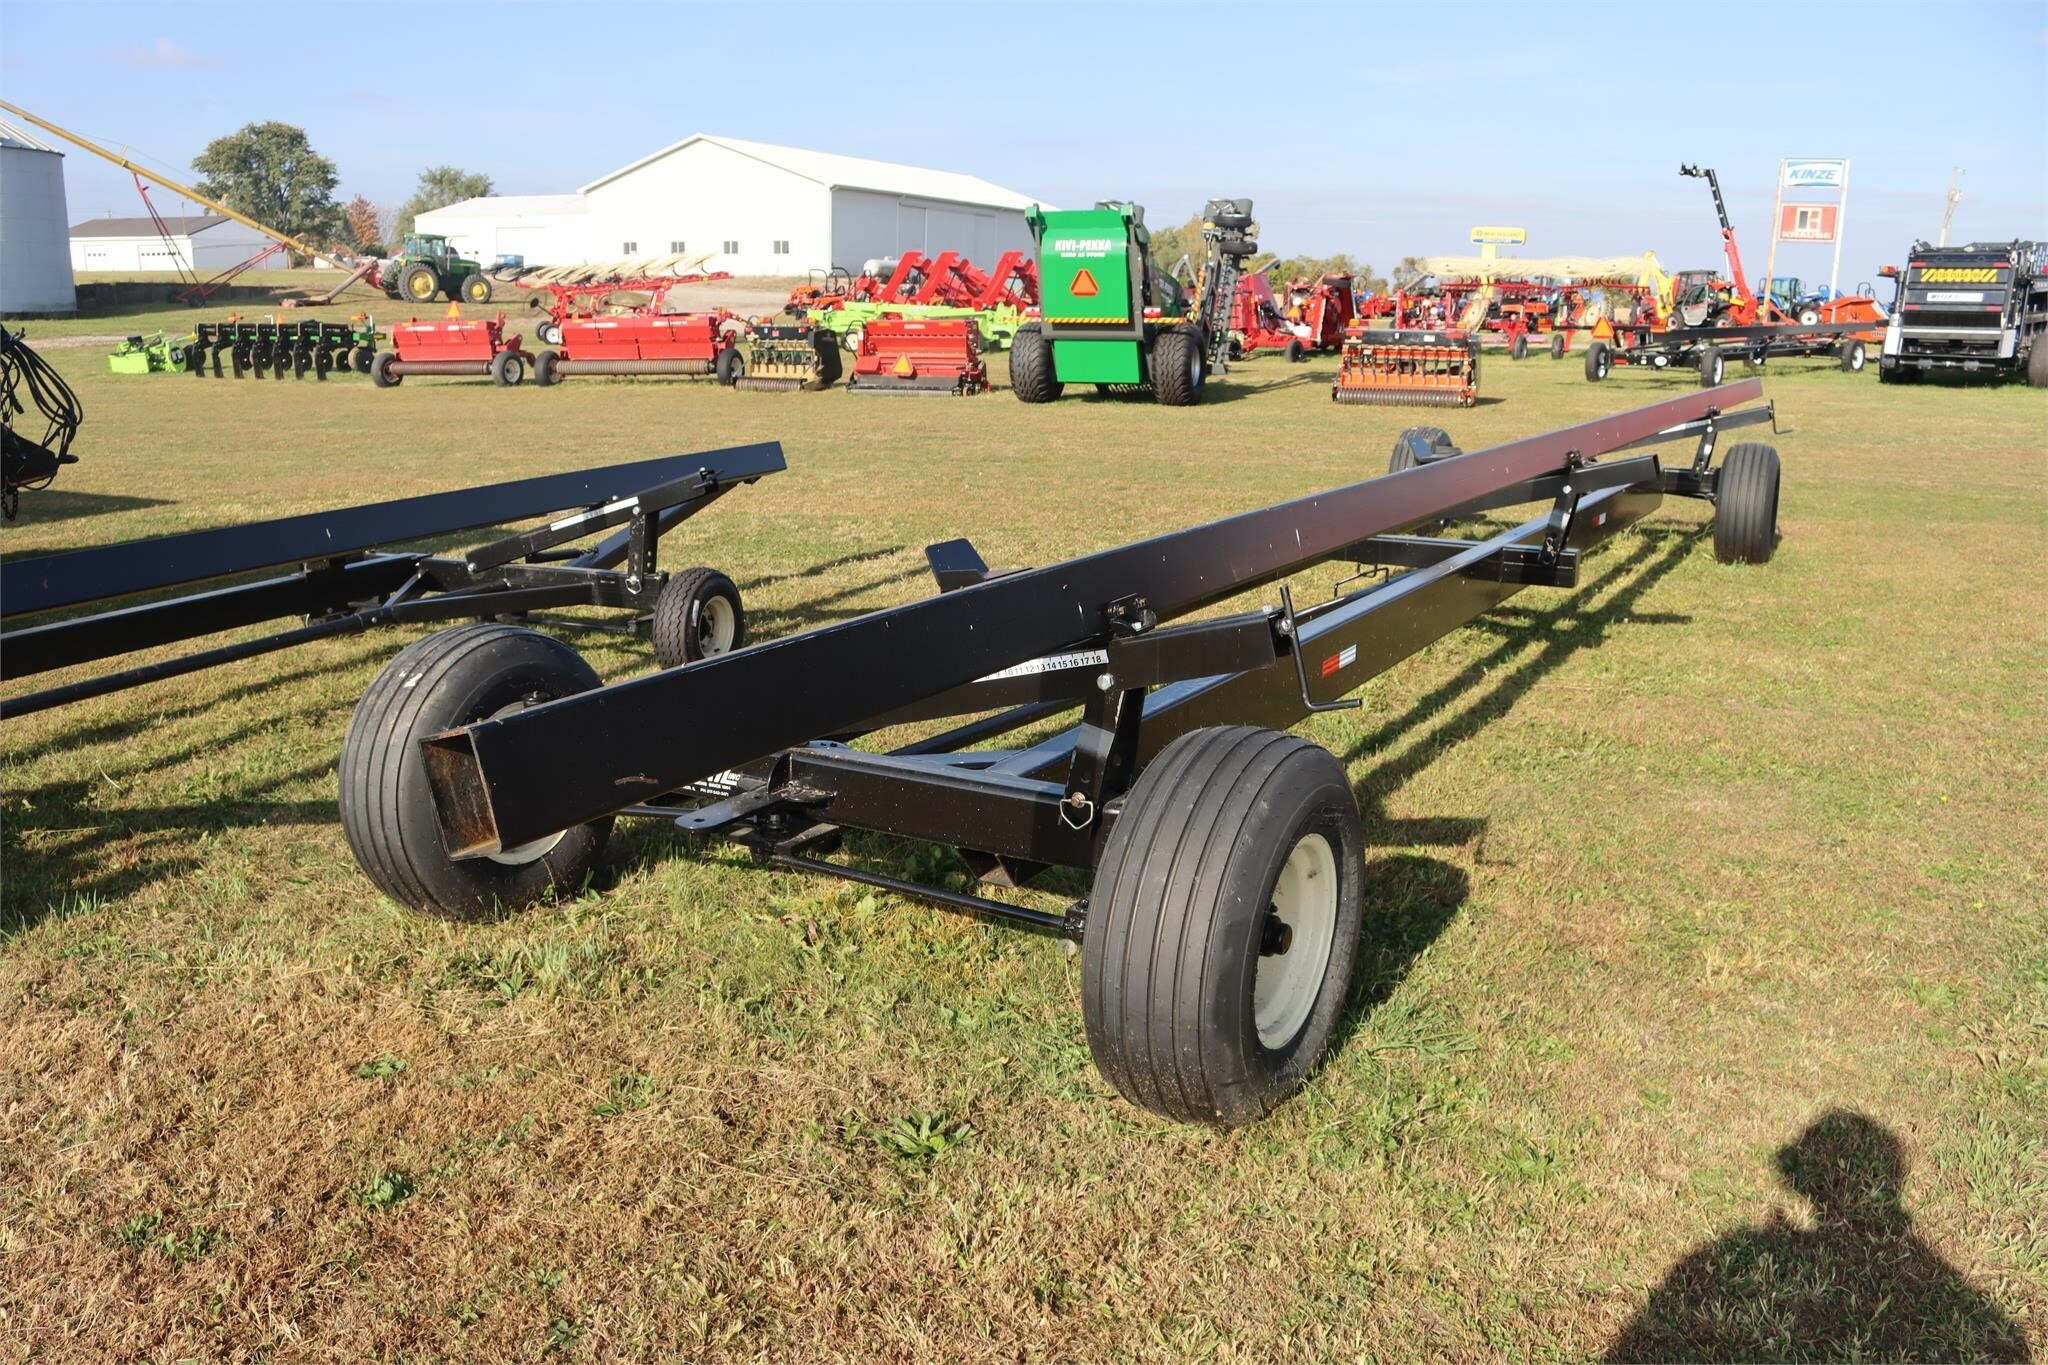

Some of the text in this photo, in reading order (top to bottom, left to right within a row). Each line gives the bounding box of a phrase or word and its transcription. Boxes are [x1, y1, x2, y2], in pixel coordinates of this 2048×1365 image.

[1789, 169, 1839, 180] KINZE
[1055, 239, 1112, 251] KIVI-PEKKA
[1026, 665, 1035, 673] 12
[1036, 663, 1046, 671] 13
[1047, 661, 1057, 670] 14
[1058, 660, 1068, 669] 15
[1069, 658, 1079, 667] 16
[1080, 657, 1090, 665] 17
[1091, 655, 1102, 664] 18
